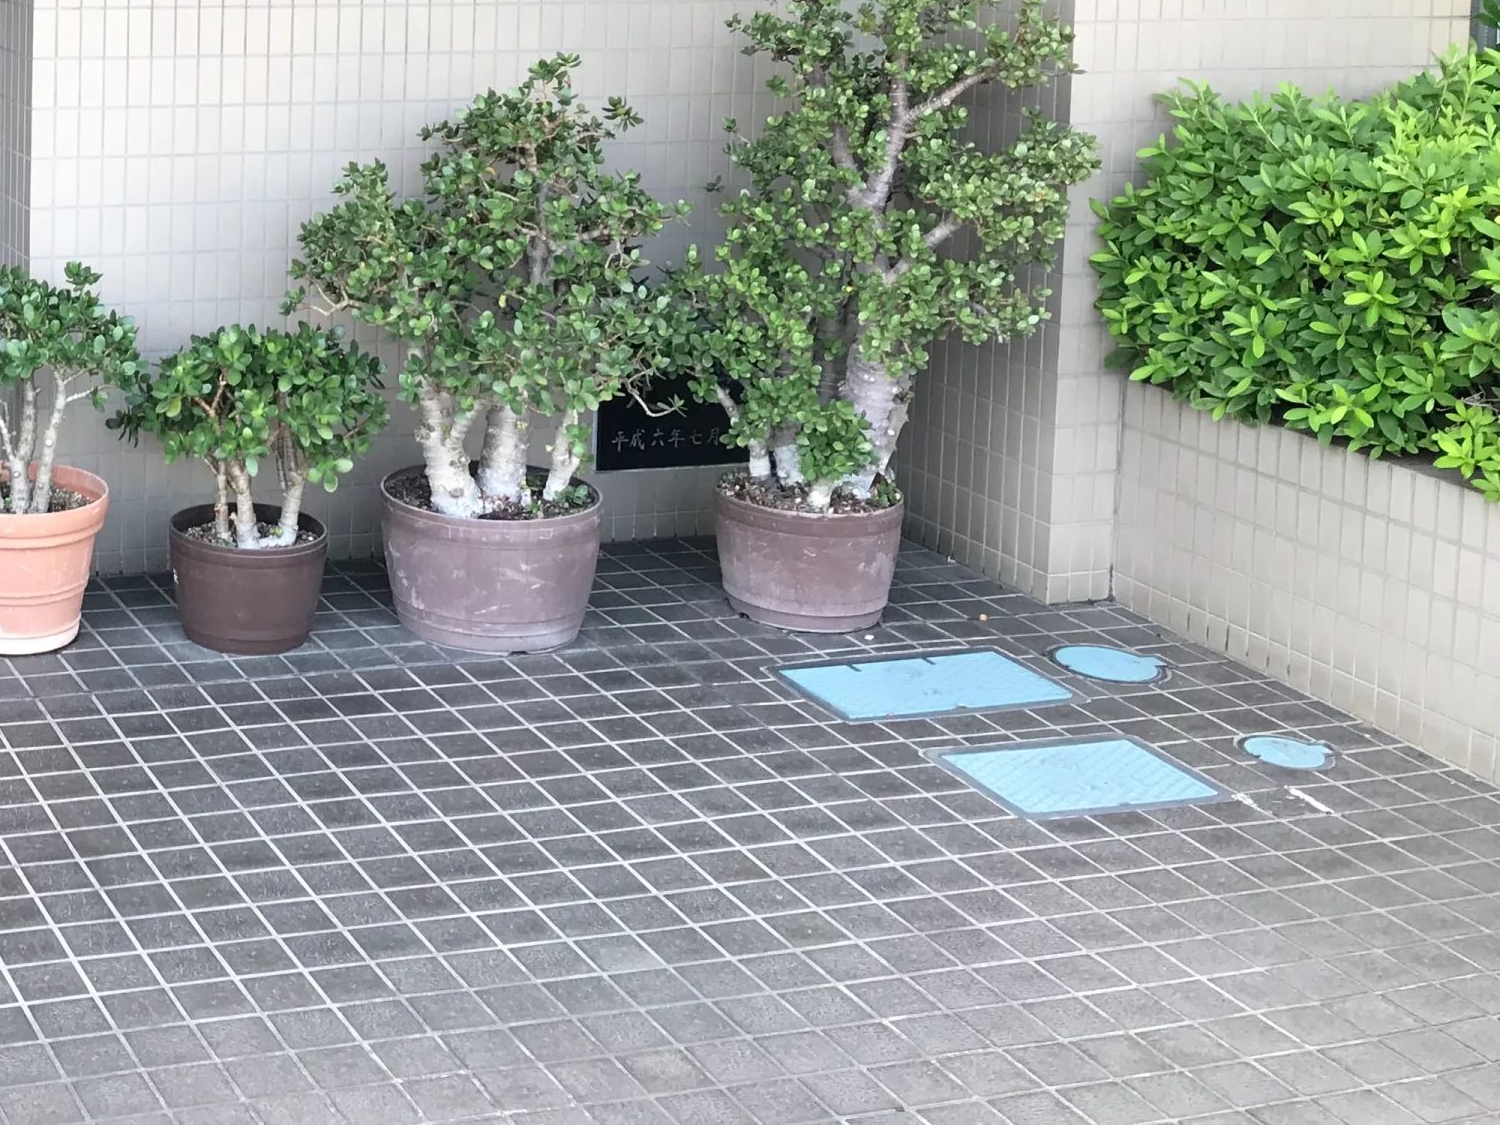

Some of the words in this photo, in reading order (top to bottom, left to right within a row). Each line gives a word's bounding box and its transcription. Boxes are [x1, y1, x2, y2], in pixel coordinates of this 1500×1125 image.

[611, 427, 720, 452] 平成六年七月
